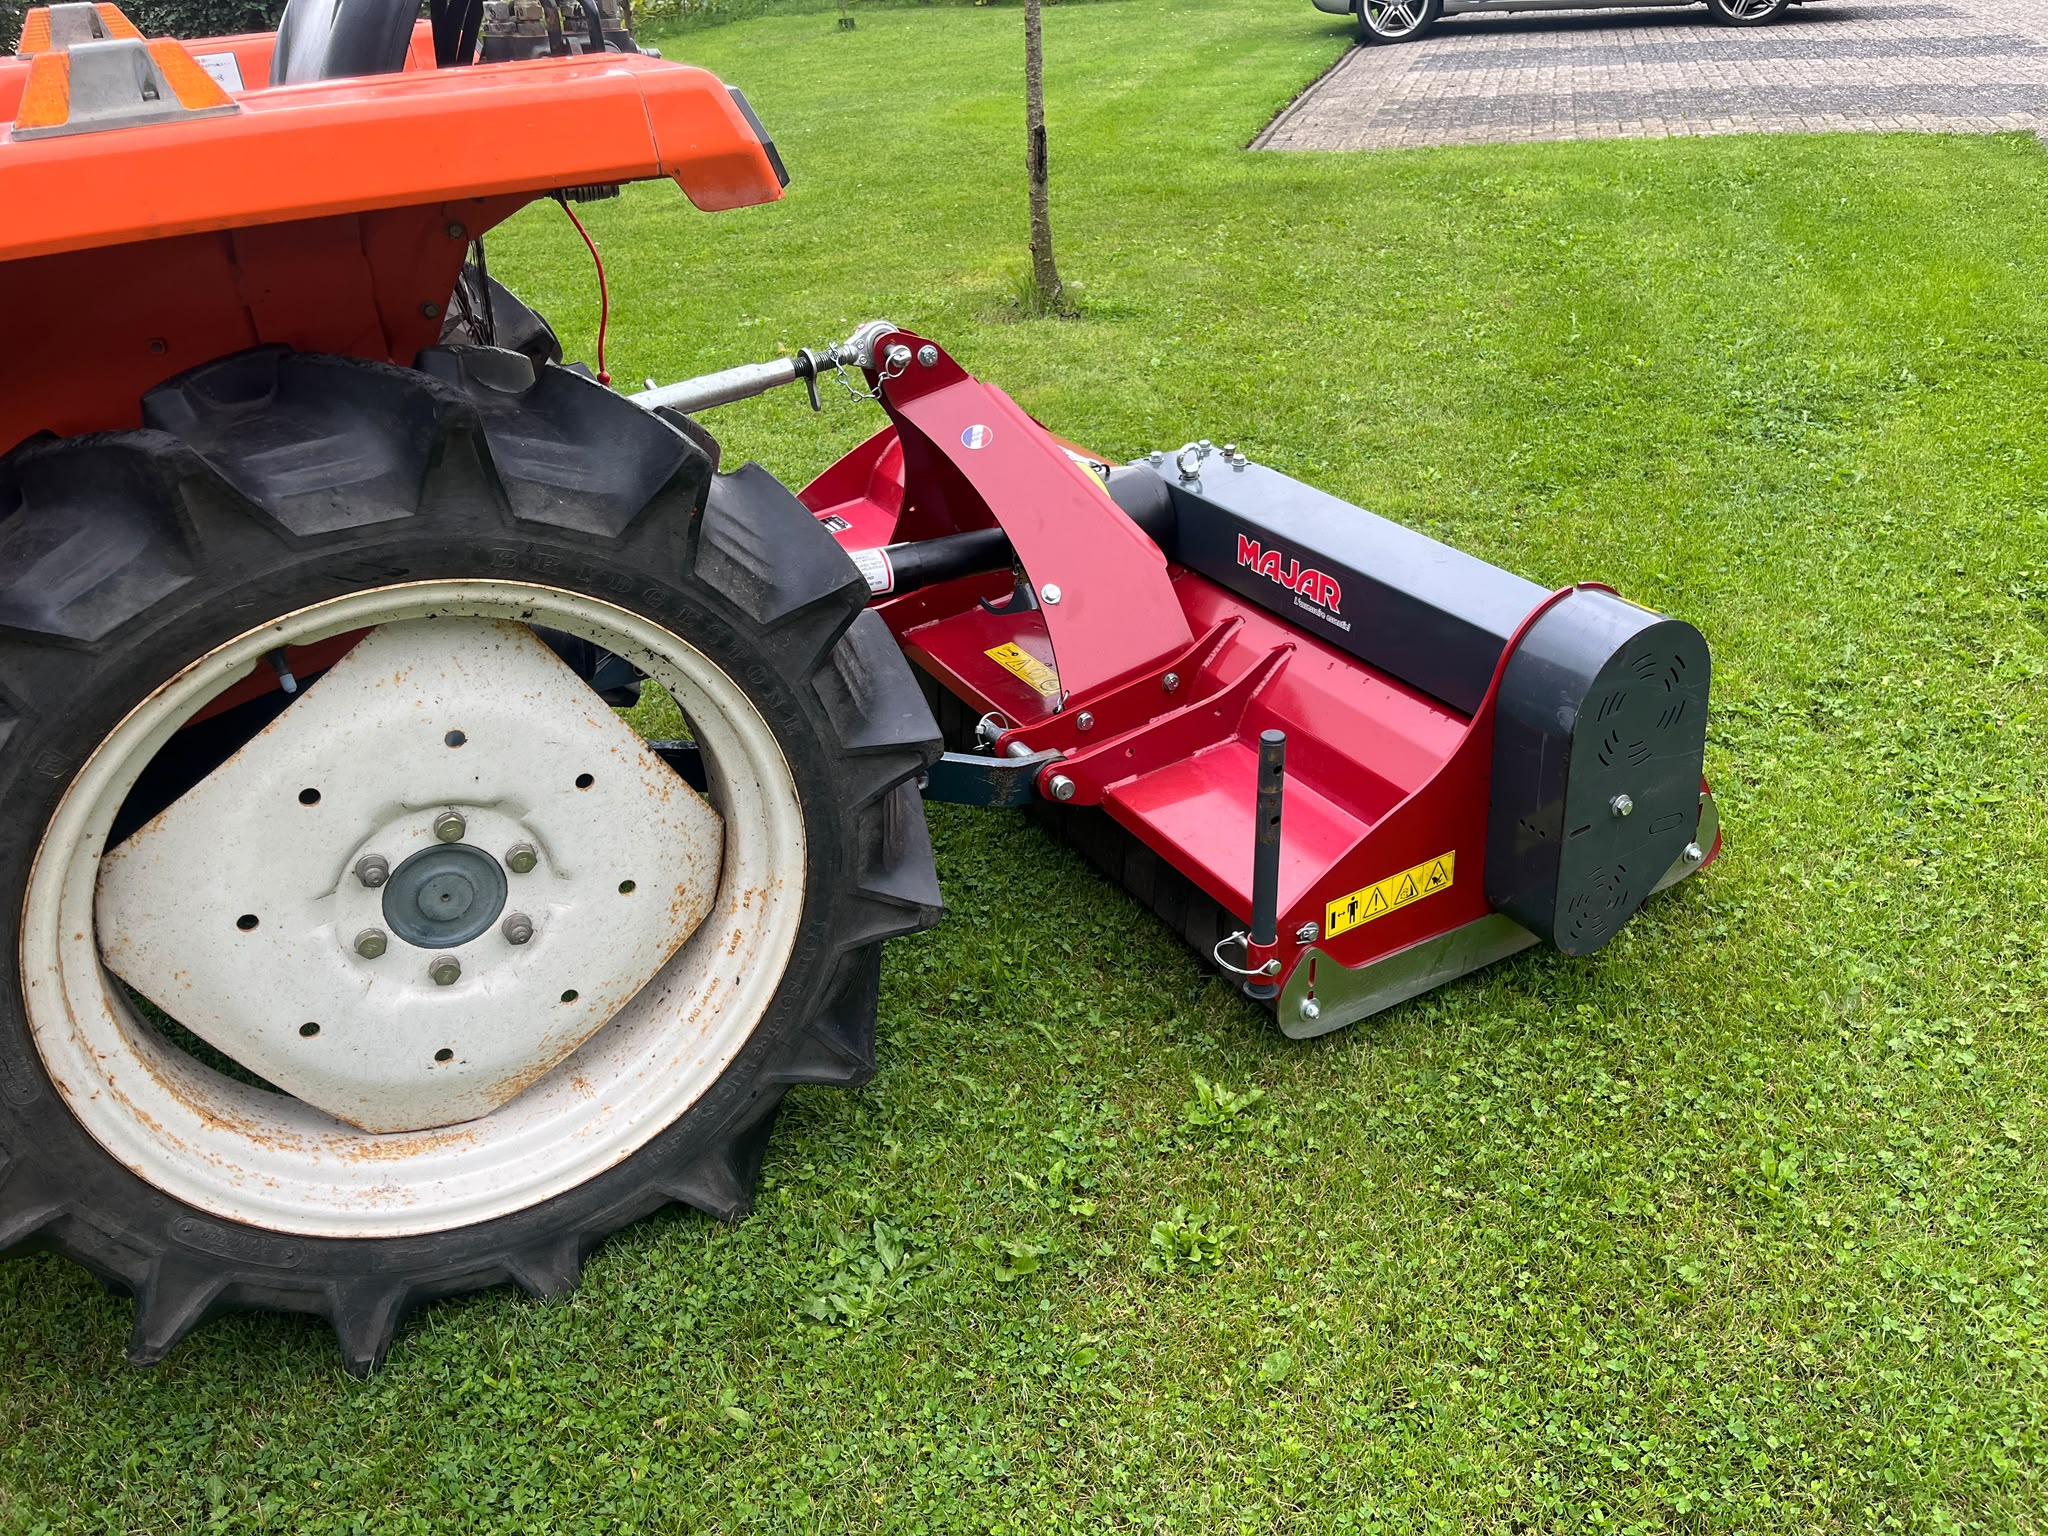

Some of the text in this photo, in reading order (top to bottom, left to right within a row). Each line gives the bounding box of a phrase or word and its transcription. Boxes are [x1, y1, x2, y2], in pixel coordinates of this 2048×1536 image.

[1237, 533, 1341, 614] MAJAR
[490, 546, 800, 738] BRIDGESTONE
[701, 977, 721, 1007] JAPAN
